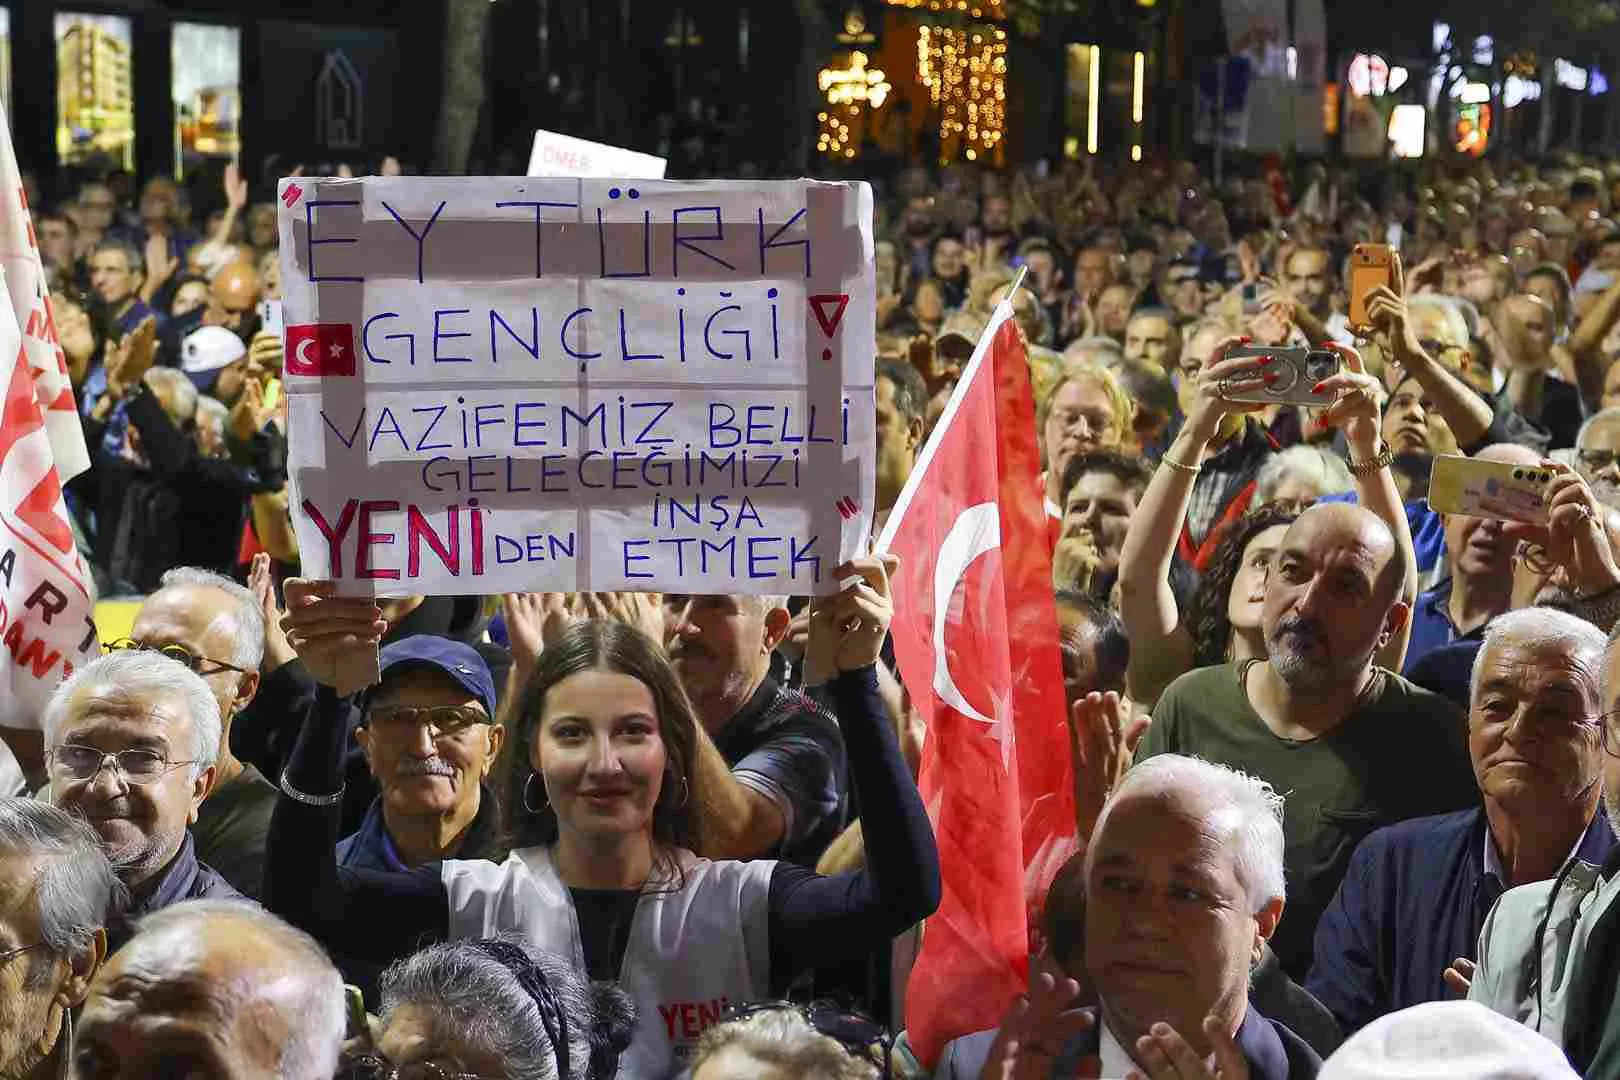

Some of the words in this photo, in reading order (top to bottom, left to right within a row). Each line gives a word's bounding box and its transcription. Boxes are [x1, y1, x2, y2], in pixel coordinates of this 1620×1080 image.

[496, 187, 811, 279] TÜRK
[320, 396, 675, 451] VAZİFEMİZ
[708, 398, 850, 447] BELLİ
[422, 444, 801, 493] GELECEĞİMİZİ
[653, 492, 765, 532] İNŞA
